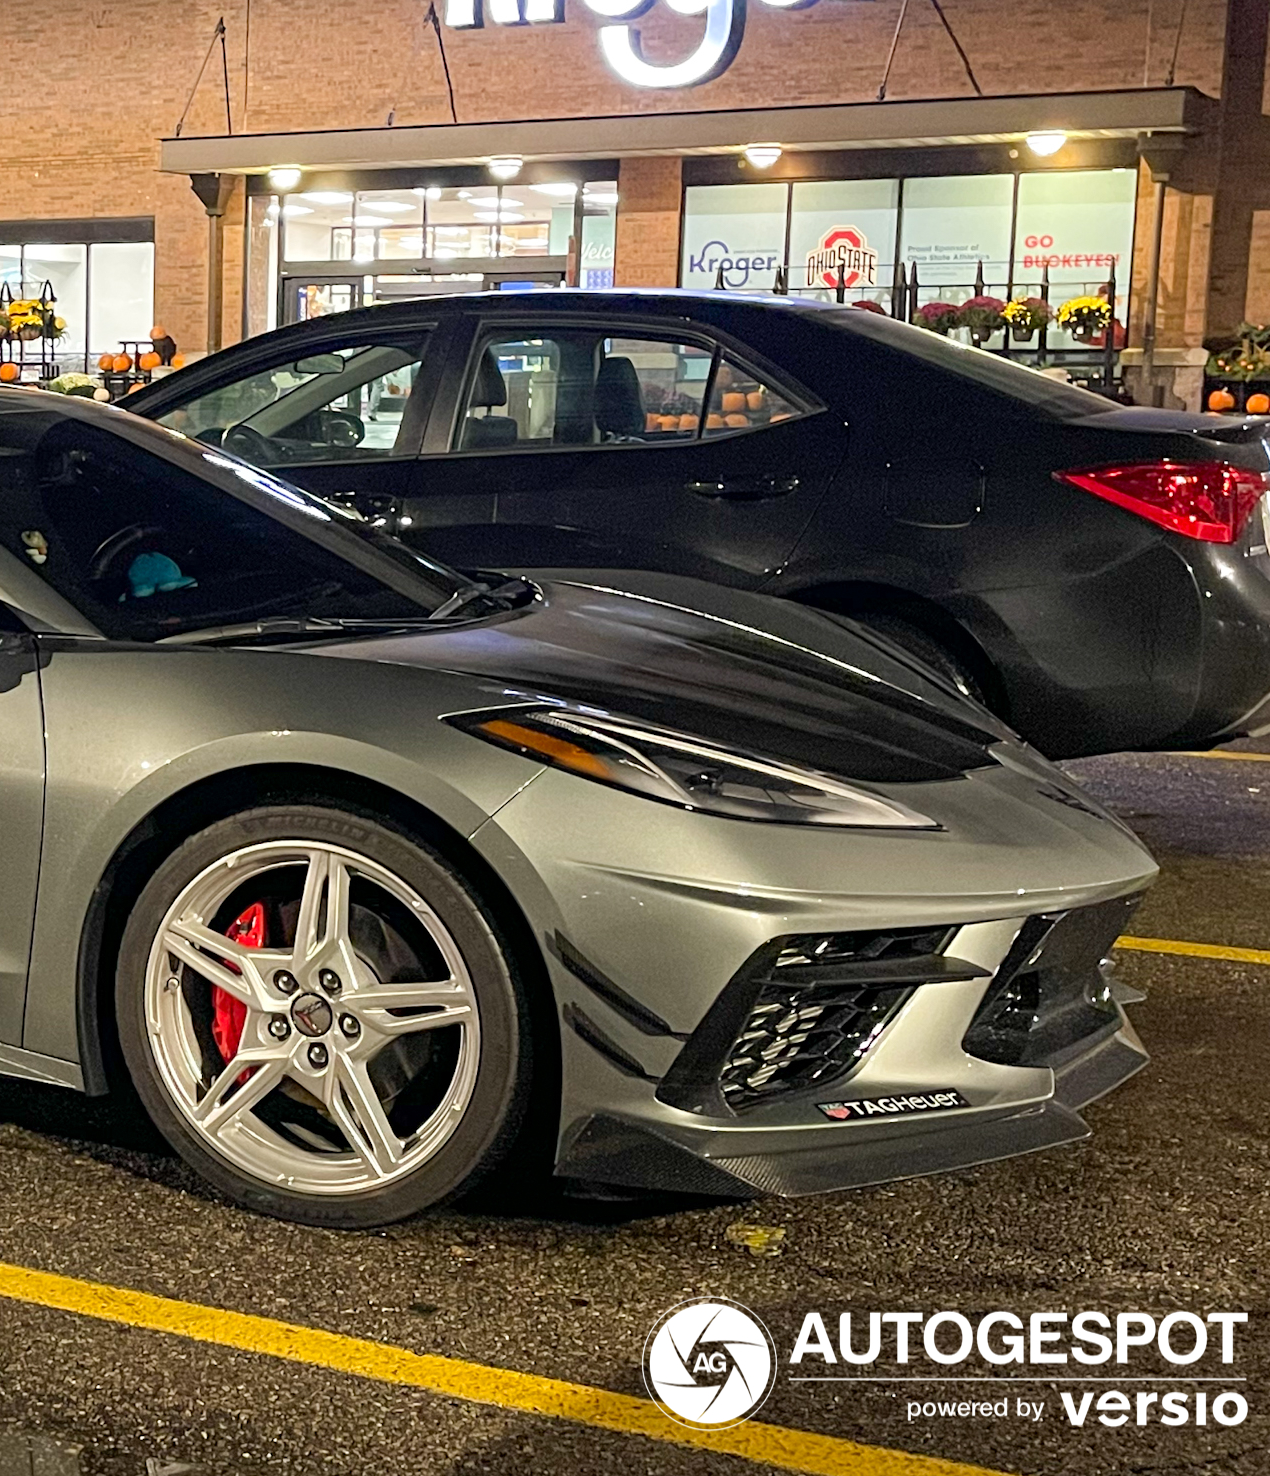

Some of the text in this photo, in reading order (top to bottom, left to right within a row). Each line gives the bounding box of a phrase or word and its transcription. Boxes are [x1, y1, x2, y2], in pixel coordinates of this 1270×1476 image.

[934, 244, 969, 252] Sponsor
[1024, 235, 1054, 249] GO
[689, 240, 777, 288] Kroger
[808, 245, 876, 286] OHIO STATE
[907, 254, 927, 262] Ohio
[266, 815, 365, 838] MICHELIN
